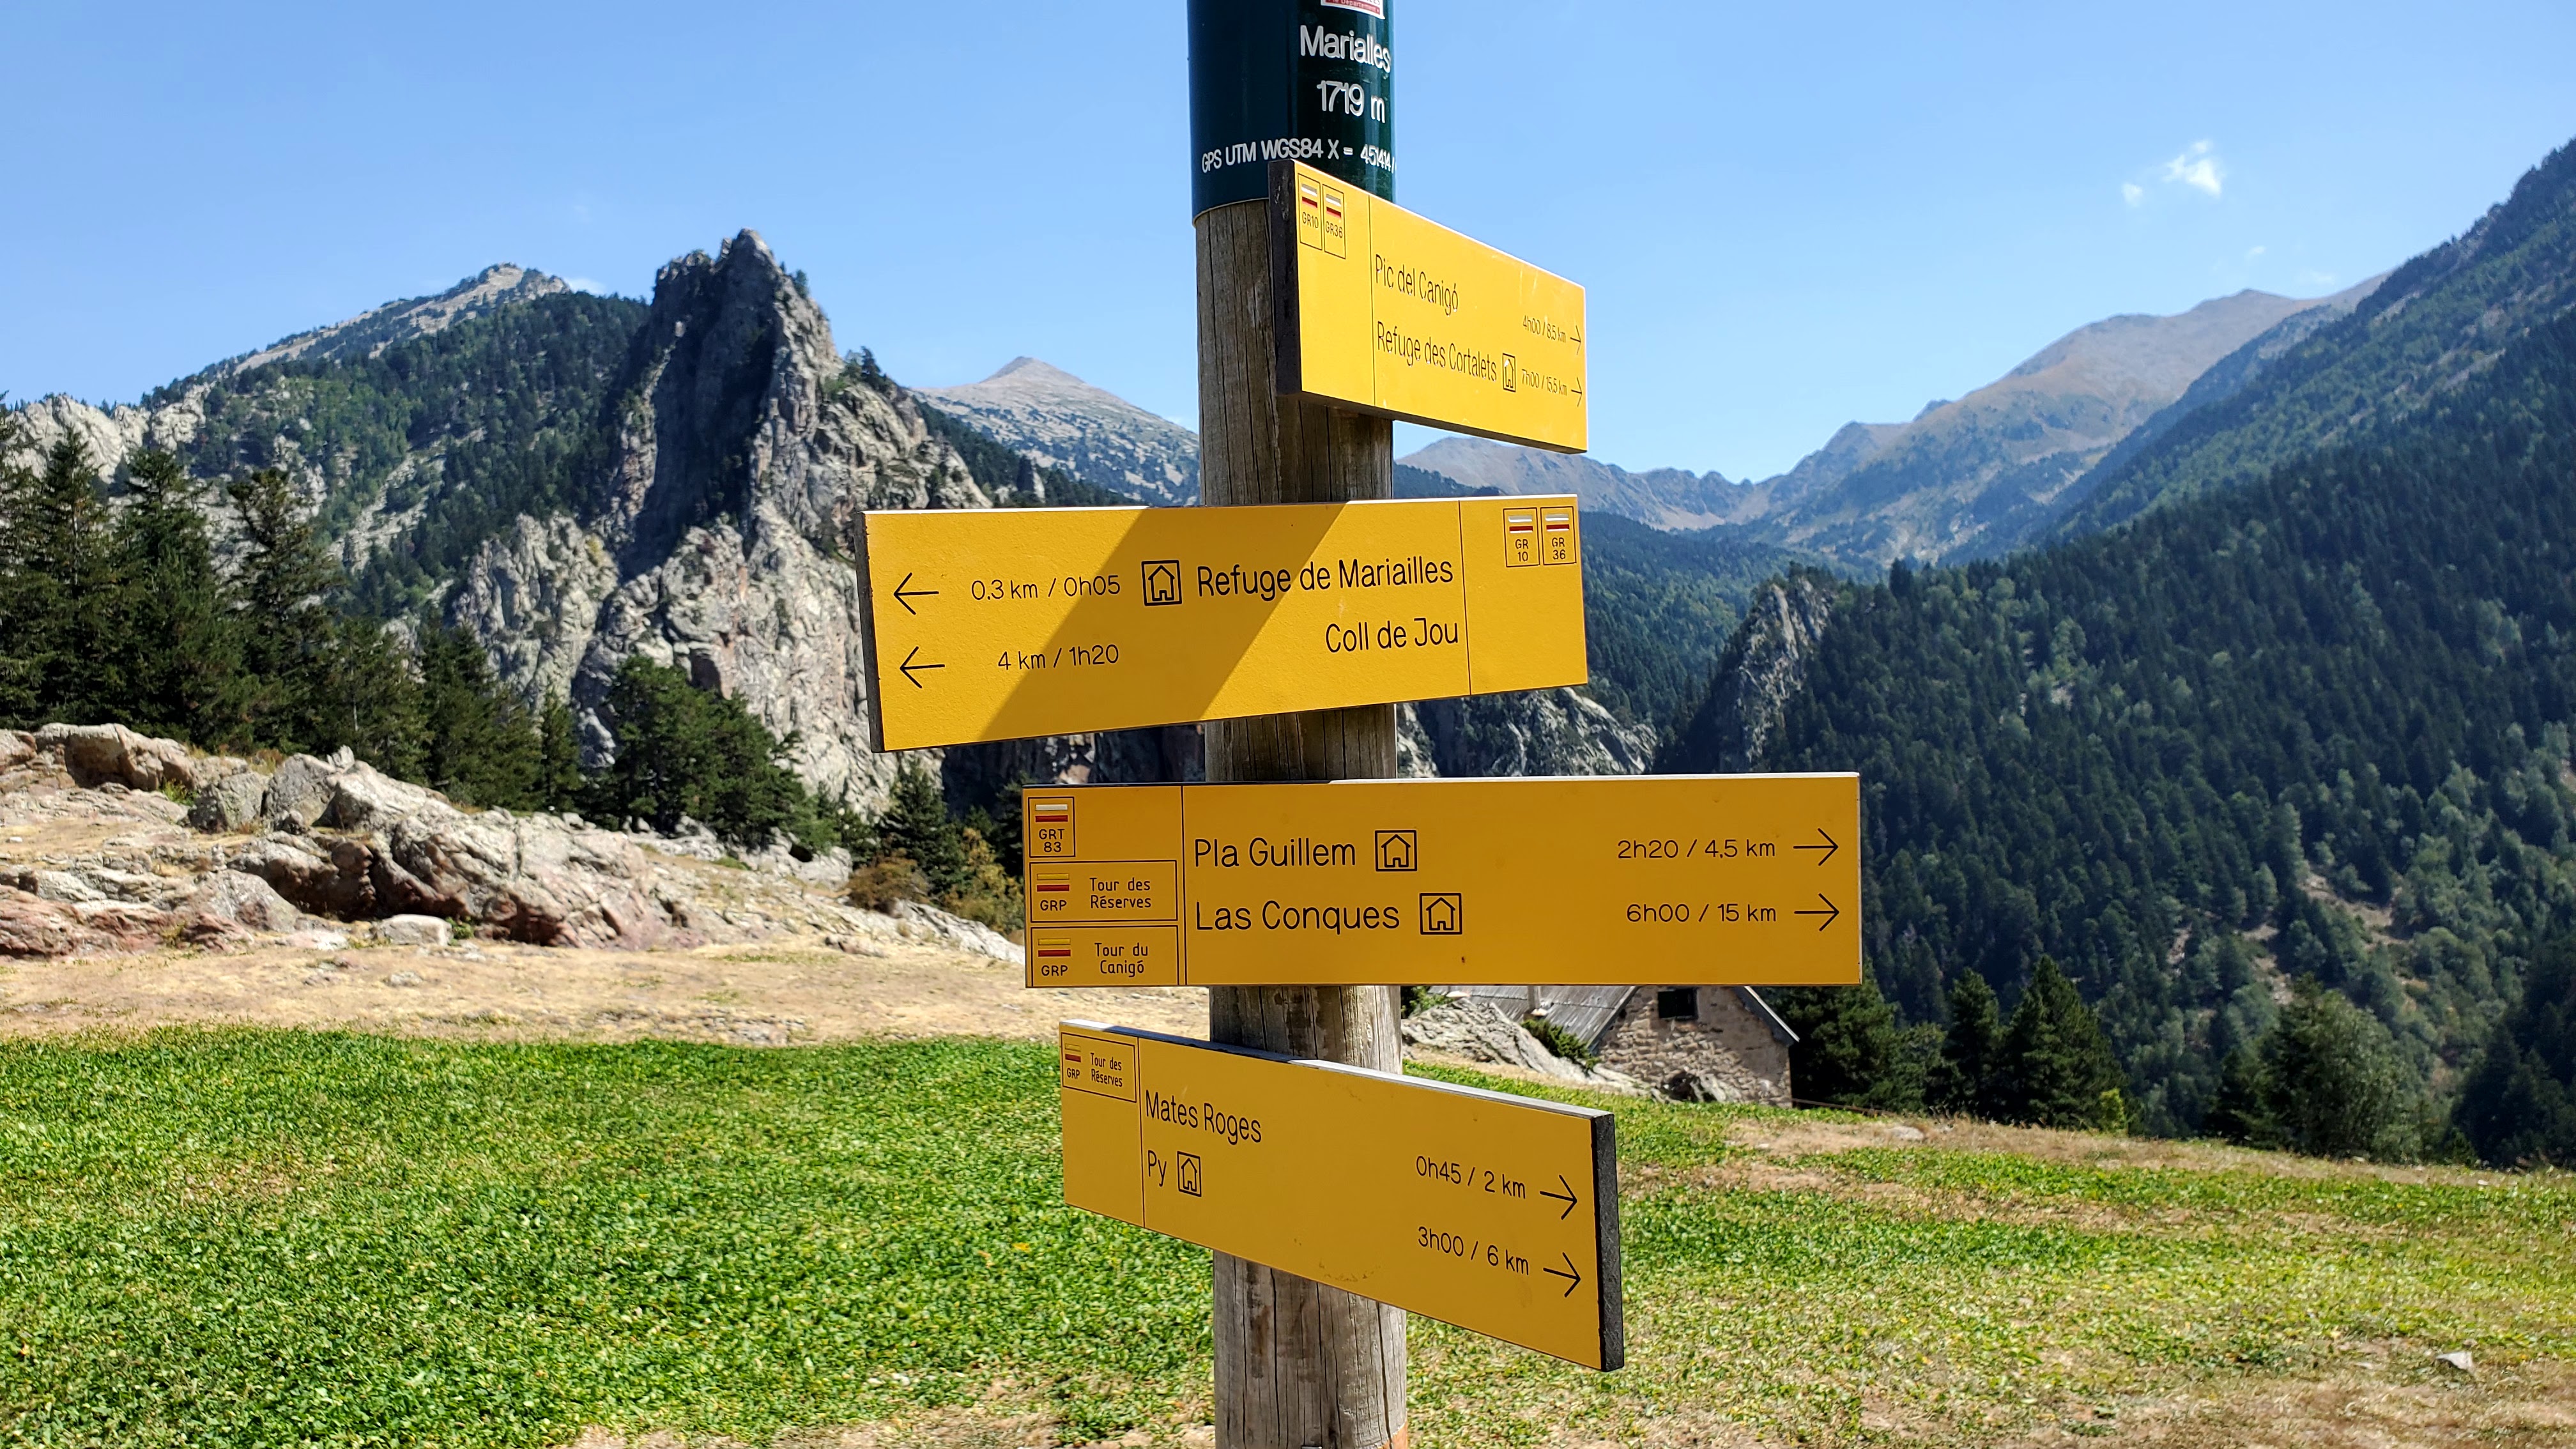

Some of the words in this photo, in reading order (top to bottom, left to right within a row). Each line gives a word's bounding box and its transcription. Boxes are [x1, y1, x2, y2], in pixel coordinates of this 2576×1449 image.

[1300, 24, 1392, 73] Marialles
[1316, 80, 1365, 117] 1719
[1370, 95, 1386, 123] m
[1201, 149, 1222, 173] GPS
[1225, 141, 1257, 165] UTM
[1261, 137, 1324, 160] WGS84
[1328, 139, 1340, 160] X
[1302, 211, 1319, 229] GR10
[1325, 220, 1343, 238] GR36
[1376, 254, 1394, 288] Pic
[1397, 264, 1416, 296] del
[1419, 271, 1459, 316] Canigó
[1522, 314, 1541, 335] 4h00
[1542, 321, 1546, 337] /
[1557, 326, 1567, 344] km
[1377, 321, 1421, 367] Refuge
[1424, 337, 1446, 367] des
[1449, 342, 1497, 381] Cortalets
[1521, 368, 1540, 388] 7h00
[1541, 374, 1545, 390] /
[1558, 379, 1567, 396] km
[1515, 539, 1529, 549] GR
[1551, 537, 1565, 548] GR
[1517, 551, 1529, 562] 10
[1552, 549, 1566, 560] 36
[1010, 579, 1038, 599] km
[1048, 578, 1057, 597] /
[1064, 574, 1121, 597] 0h05
[1197, 564, 1291, 602] Refuge
[1300, 561, 1331, 590] de
[1338, 555, 1453, 588] Mariailles
[1326, 622, 1369, 653] Coll
[1377, 620, 1407, 649] de
[1413, 617, 1459, 647] Jou
[998, 651, 1011, 670] 4
[1018, 650, 1046, 670] km
[1053, 647, 1062, 668] /
[1069, 644, 1119, 666] 1h20
[1038, 828, 1065, 840] GRT
[1043, 841, 1062, 853] 83
[1195, 838, 1239, 868] Pla
[1249, 837, 1356, 867] Guillem
[1618, 839, 1678, 859] 2h20
[1686, 839, 1698, 857] /
[1705, 839, 1738, 859] 4,5
[1746, 839, 1775, 857] km
[1089, 877, 1120, 892] Tour
[1128, 877, 1151, 891] des
[1039, 900, 1067, 911] GRP
[1091, 894, 1151, 908] Réserves
[1196, 901, 1252, 930] Las
[1262, 900, 1400, 935] Conques
[1627, 903, 1690, 923] 6h00
[1698, 903, 1710, 923] /
[1717, 903, 1740, 922] 15
[1747, 904, 1776, 922] km
[1094, 942, 1125, 957] Tour
[1132, 942, 1148, 956] du
[1041, 965, 1068, 977] GRP
[1100, 960, 1144, 977] Canigó
[1090, 1052, 1106, 1068] Tour
[1109, 1056, 1122, 1071] des
[1066, 1068, 1080, 1079] GRP
[1091, 1068, 1123, 1087] Réserves
[1146, 1089, 1199, 1128] Mates
[1204, 1102, 1262, 1146] Roges
[1147, 1149, 1167, 1187] Py
[1416, 1155, 1461, 1184] 0h45
[1467, 1167, 1475, 1186] /
[1484, 1170, 1496, 1193] 2
[1502, 1174, 1526, 1199] km
[1418, 1226, 1464, 1257] 3h00
[1470, 1241, 1479, 1261] /
[1487, 1245, 1499, 1266] 6
[1505, 1249, 1529, 1276] km
